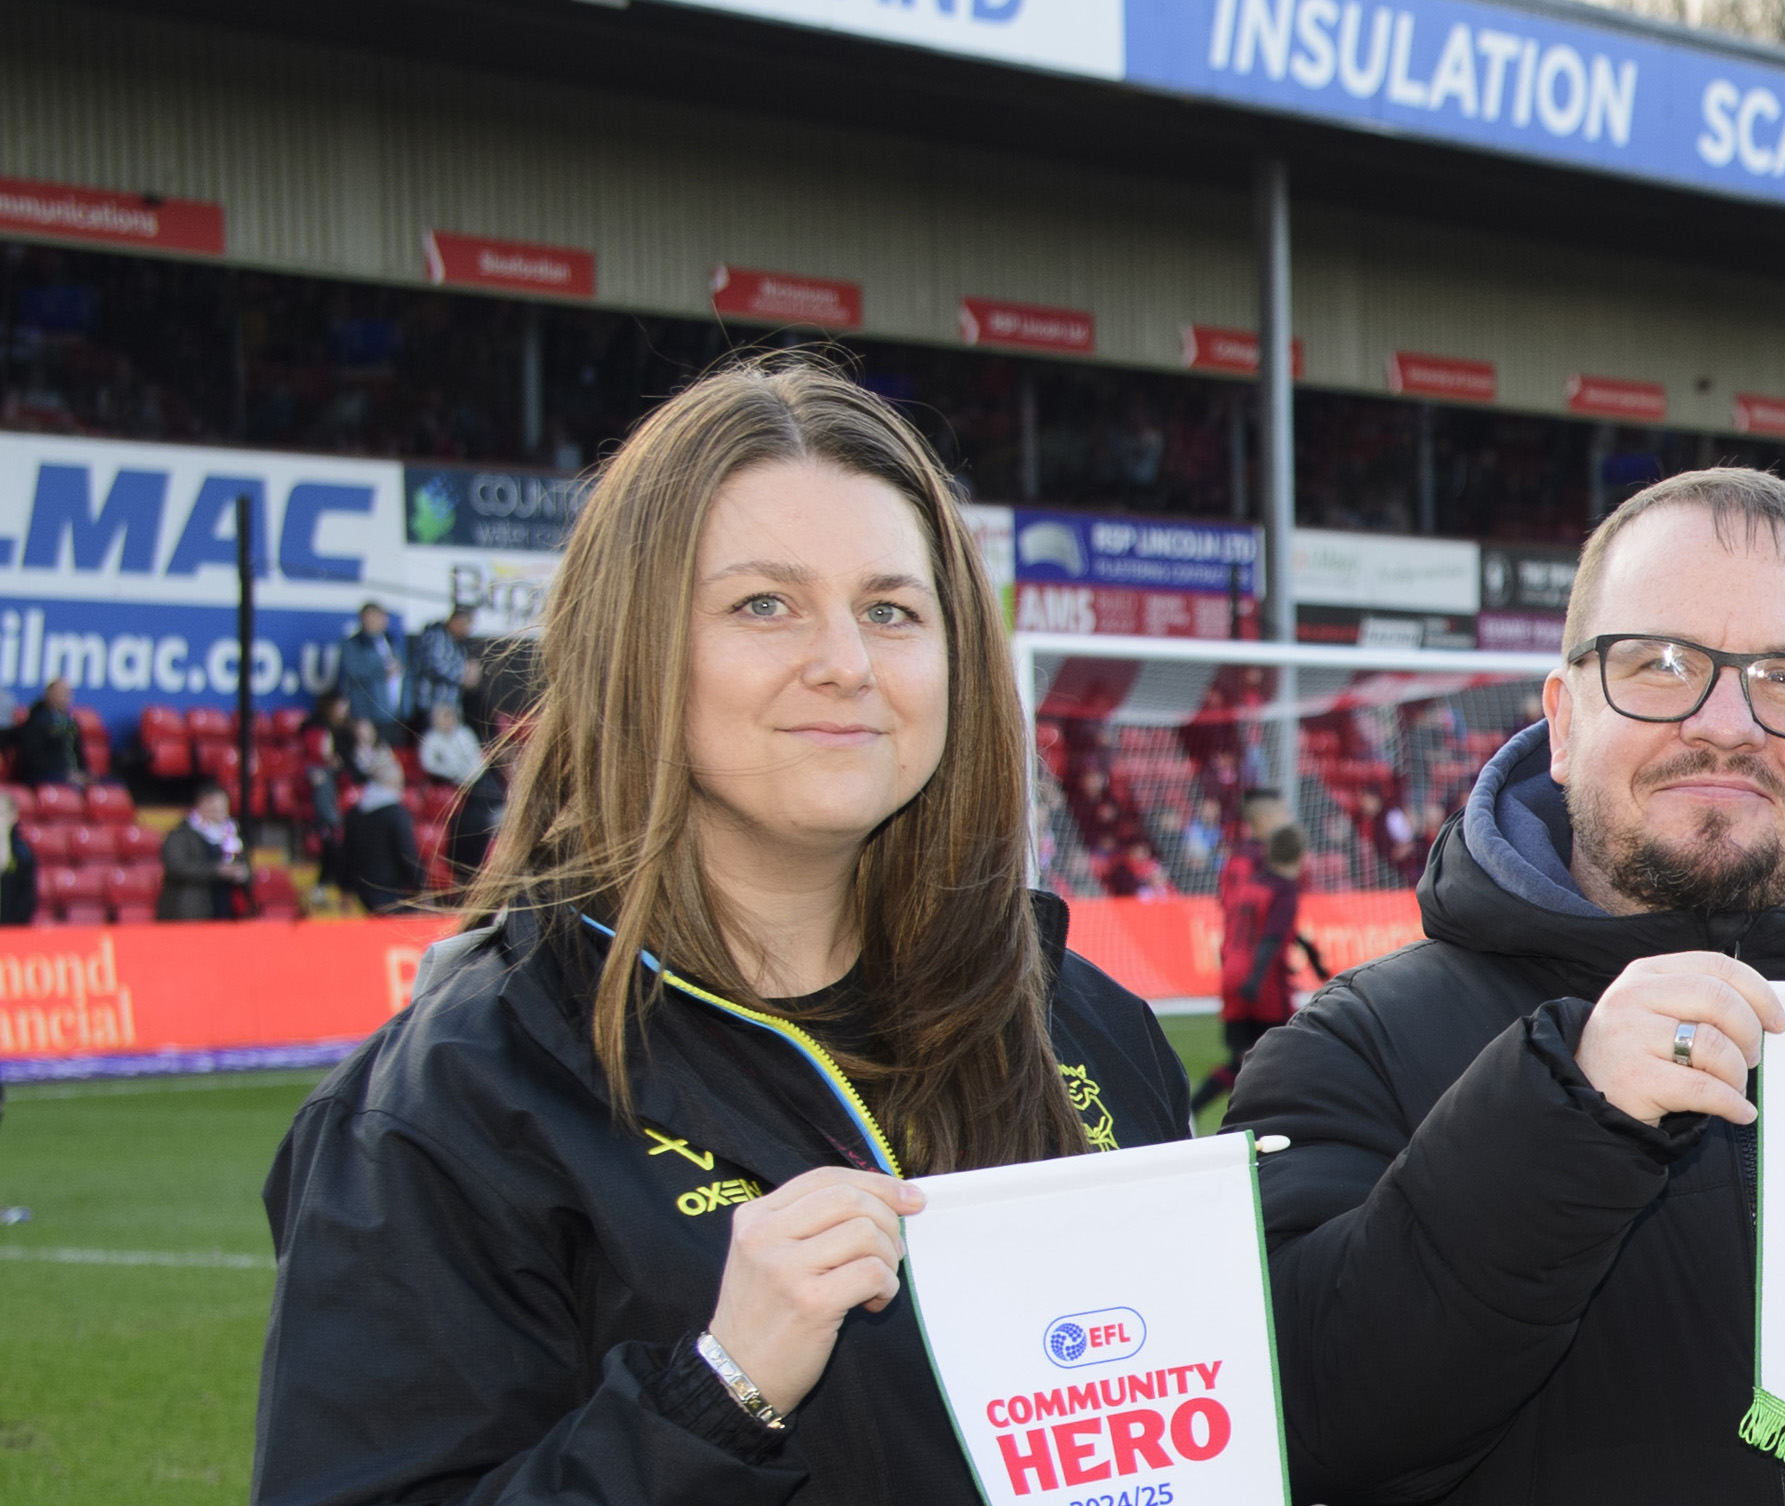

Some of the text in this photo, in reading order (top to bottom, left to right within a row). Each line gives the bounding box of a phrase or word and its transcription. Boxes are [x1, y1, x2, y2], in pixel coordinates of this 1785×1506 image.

[1209, 0, 1638, 147] INSULATION
[0, 463, 377, 582] MAC
[1016, 584, 1097, 634] AMS
[0, 608, 357, 695] ilmac.co.u
[676, 1178, 763, 1216] OXEN
[1089, 1323, 1131, 1348] EFL
[986, 1360, 1223, 1429] COMMUNITY
[996, 1397, 1232, 1496] HERO
